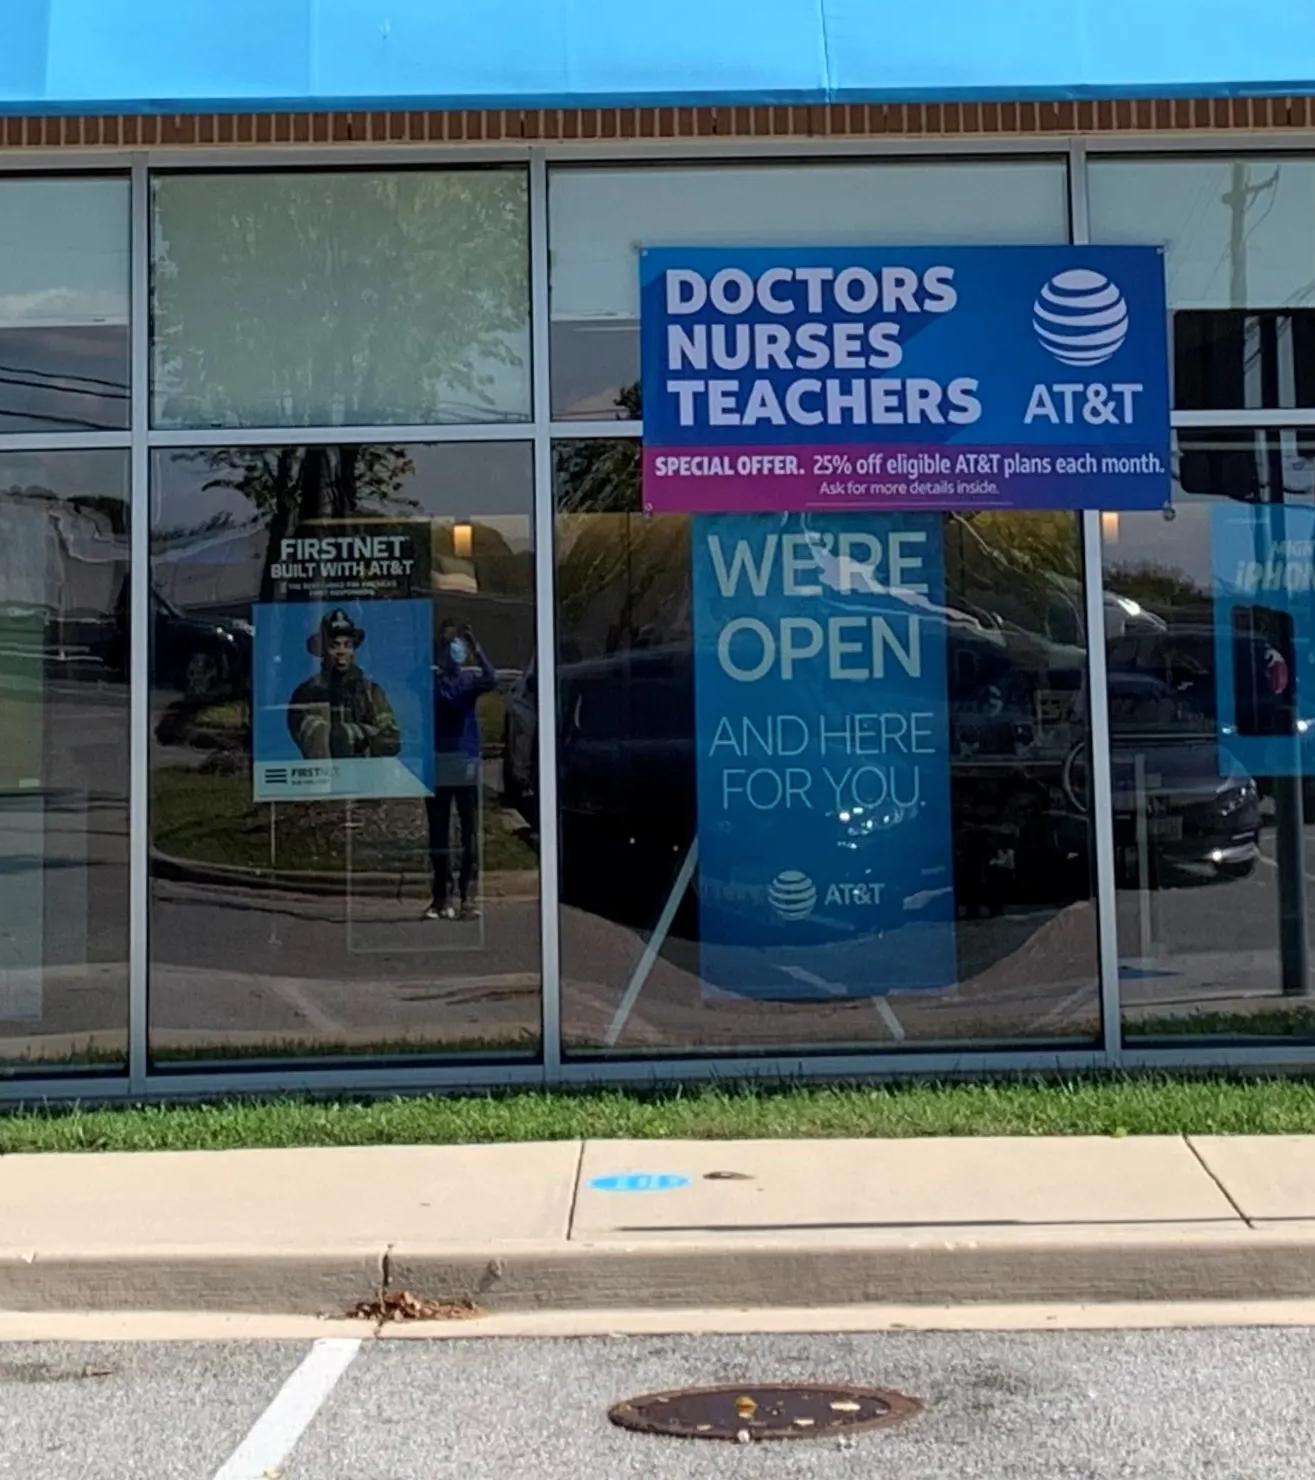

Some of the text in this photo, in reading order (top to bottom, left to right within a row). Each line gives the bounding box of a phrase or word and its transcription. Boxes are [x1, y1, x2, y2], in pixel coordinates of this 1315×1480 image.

[666, 266, 959, 316] DOCTORS
[666, 322, 903, 371] NURSES
[666, 377, 982, 427] TEACHERS
[1023, 382, 1144, 425] AT&T
[654, 453, 1165, 480] SPECIAL OFFER. 25% off eligible AT&T plans each month.
[819, 480, 1000, 496] Ask for more details inside.
[270, 559, 414, 579] BUILT WITH AT&T
[280, 535, 406, 561] FIRSTNET
[707, 531, 929, 598] WE'RE
[716, 614, 922, 682] OPEN
[709, 713, 936, 757] AND HERE
[722, 767, 812, 810] FOR
[824, 883, 885, 906] AT&T
